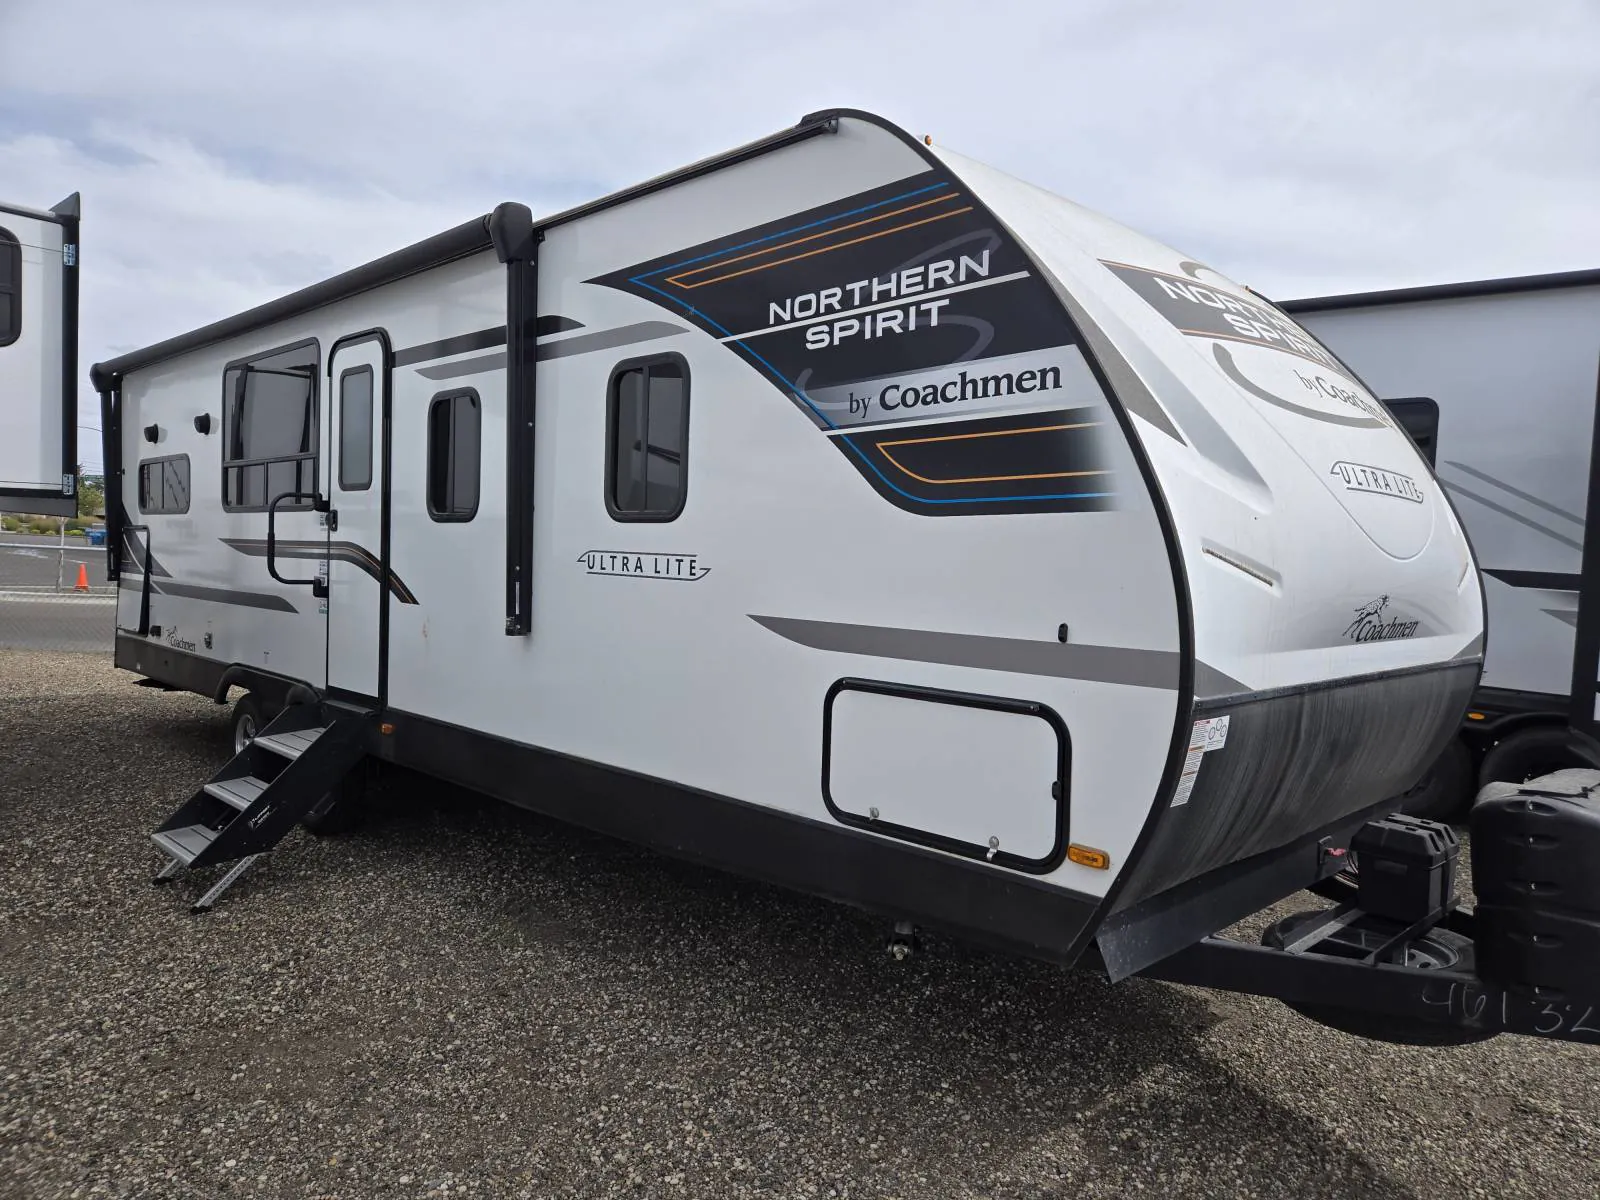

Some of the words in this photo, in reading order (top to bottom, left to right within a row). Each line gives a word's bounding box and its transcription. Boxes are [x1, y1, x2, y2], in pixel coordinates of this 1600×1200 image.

[768, 248, 990, 325] NORTHERN
[804, 298, 950, 350] SPIRIT
[849, 392, 873, 419] by
[878, 365, 1063, 412] Coachmen
[1292, 369, 1323, 398] by
[1314, 375, 1387, 422] Coachm
[1338, 464, 1393, 492] ULTRA
[1393, 475, 1421, 499] LITE
[587, 554, 643, 573] ULTRA
[654, 557, 697, 577] LITE
[1355, 615, 1420, 643] Coachmen
